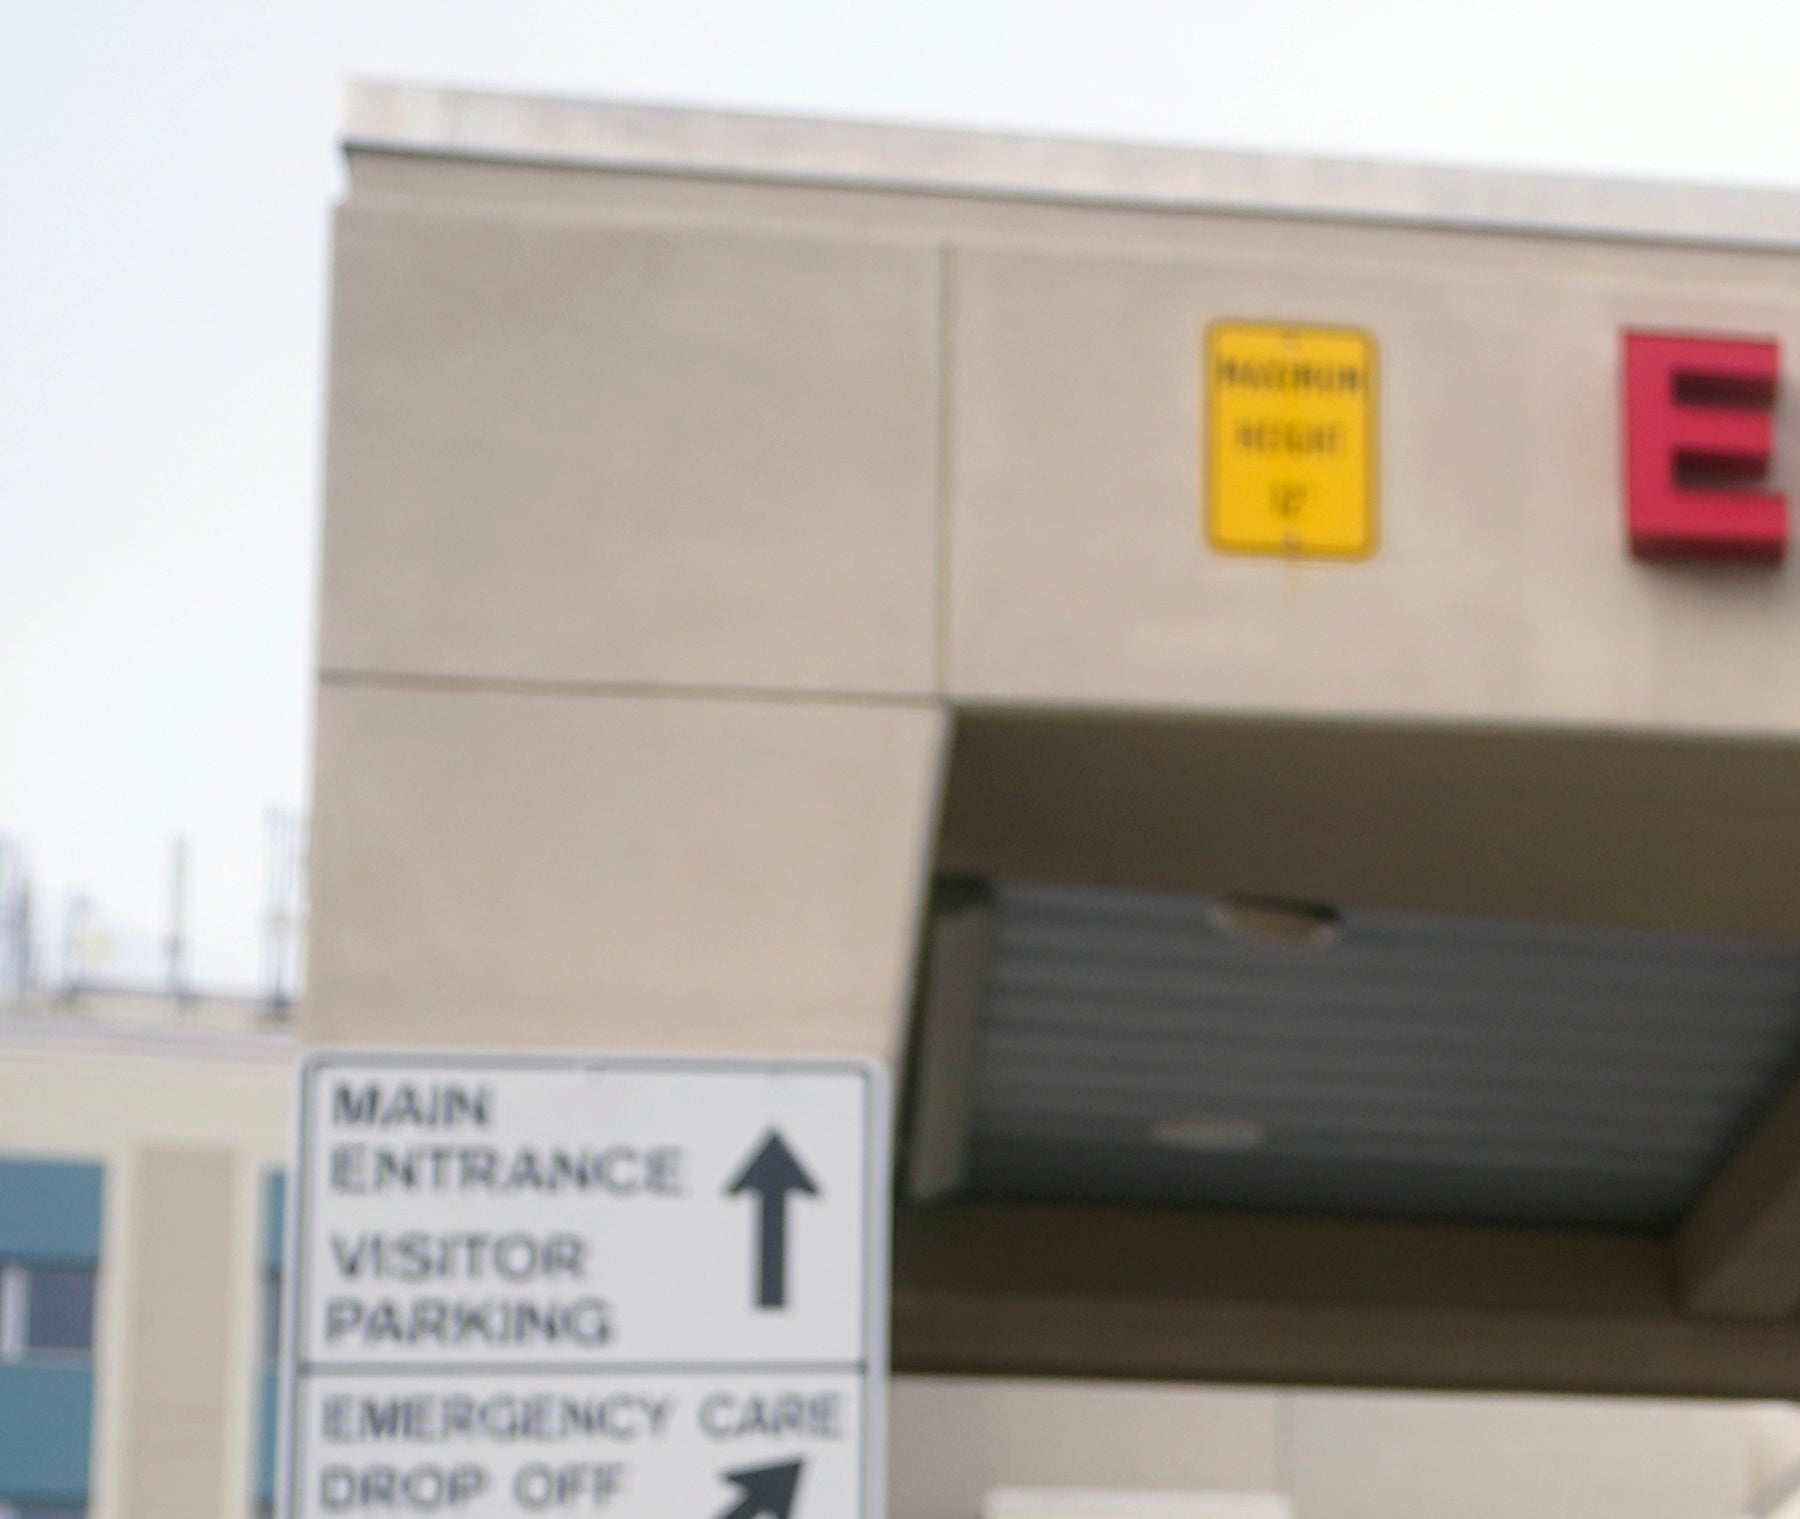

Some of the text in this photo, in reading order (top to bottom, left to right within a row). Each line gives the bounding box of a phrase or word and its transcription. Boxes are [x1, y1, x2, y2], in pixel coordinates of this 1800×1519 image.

[330, 1082, 493, 1128] MAIN
[330, 1146, 686, 1196] ENTRANCE
[330, 1229, 584, 1281] VISITOR
[324, 1298, 613, 1347] PARKING
[322, 1392, 845, 1443] EMERGENCY CARE
[320, 1463, 626, 1513] DROP OFF
